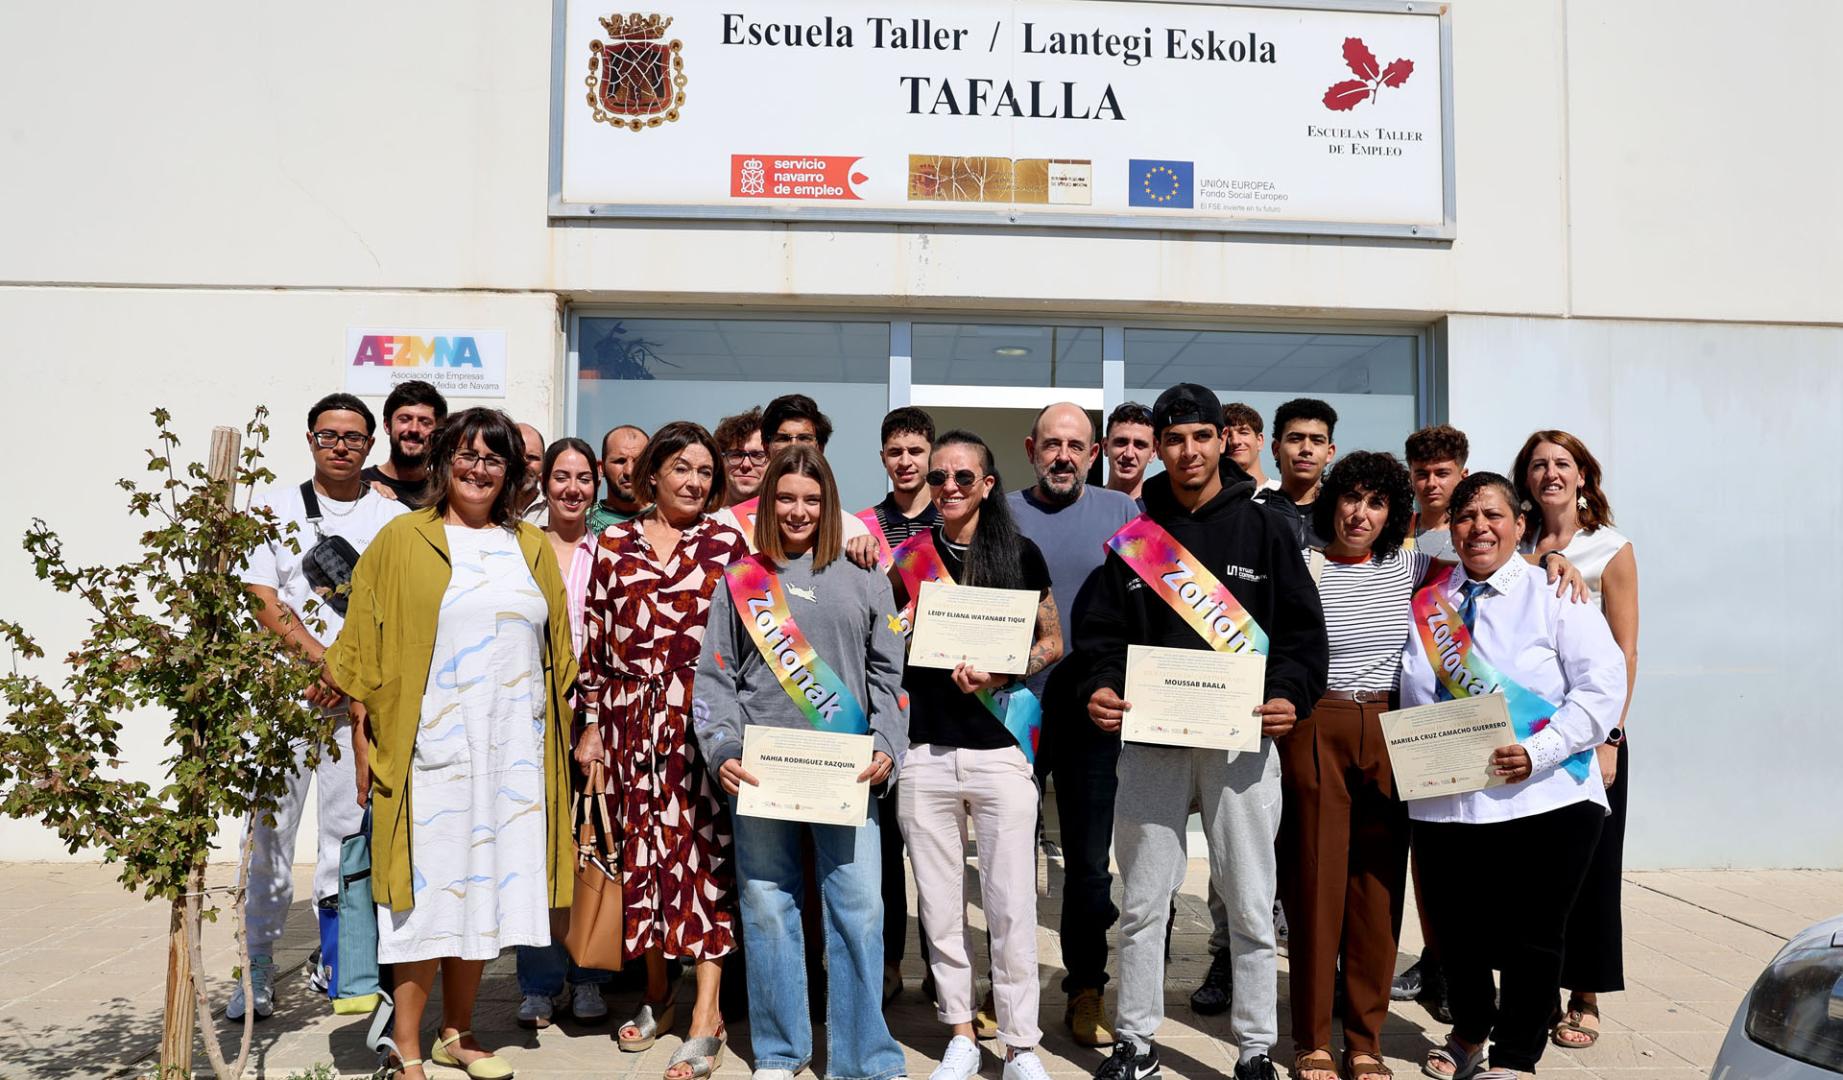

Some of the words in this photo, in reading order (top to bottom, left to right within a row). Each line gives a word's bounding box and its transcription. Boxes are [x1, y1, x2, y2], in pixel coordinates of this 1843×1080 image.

[720, 13, 853, 48] Escuela
[866, 16, 969, 51] Taller
[988, 21, 1000, 52] /
[1022, 22, 1153, 67] Lantegi
[1164, 28, 1277, 64] Eskola
[899, 76, 1127, 121] TAFALLA
[773, 158, 826, 170] servicio
[773, 172, 825, 183] navarro
[1200, 178, 1229, 189] UNIÓN
[1231, 180, 1276, 191] EUROPEA
[773, 184, 791, 195] de
[793, 184, 844, 197] empleo
[1200, 189, 1226, 198] Fondo
[1228, 190, 1253, 200] Social
[1254, 191, 1289, 202] Europeo
[352, 335, 483, 368] AEZMNA
[390, 371, 433, 380] Asociación
[434, 371, 445, 380] de
[446, 372, 485, 382] Empresas
[457, 382, 468, 390] de
[469, 382, 500, 391] Navarra
[1161, 559, 1264, 656] Zorion
[927, 609, 946, 617] LEIDY
[946, 611, 970, 620] ELIANA
[971, 613, 1006, 622] WATANABE
[1007, 616, 1026, 624] TIQUE
[1427, 601, 1504, 695] Zoriona
[747, 589, 843, 724] Zorionak
[1164, 679, 1200, 688] MOUSSAB
[1201, 681, 1227, 690] BAALA
[1390, 735, 1420, 746] MARIELA
[1420, 732, 1437, 741] CRUZ
[1438, 727, 1472, 738] CAMACHO
[1472, 721, 1507, 733] GUERRERO
[760, 754, 783, 763] NAHIA
[784, 757, 823, 766] RODRIGUEZ
[823, 760, 856, 769] RAZQUIN
